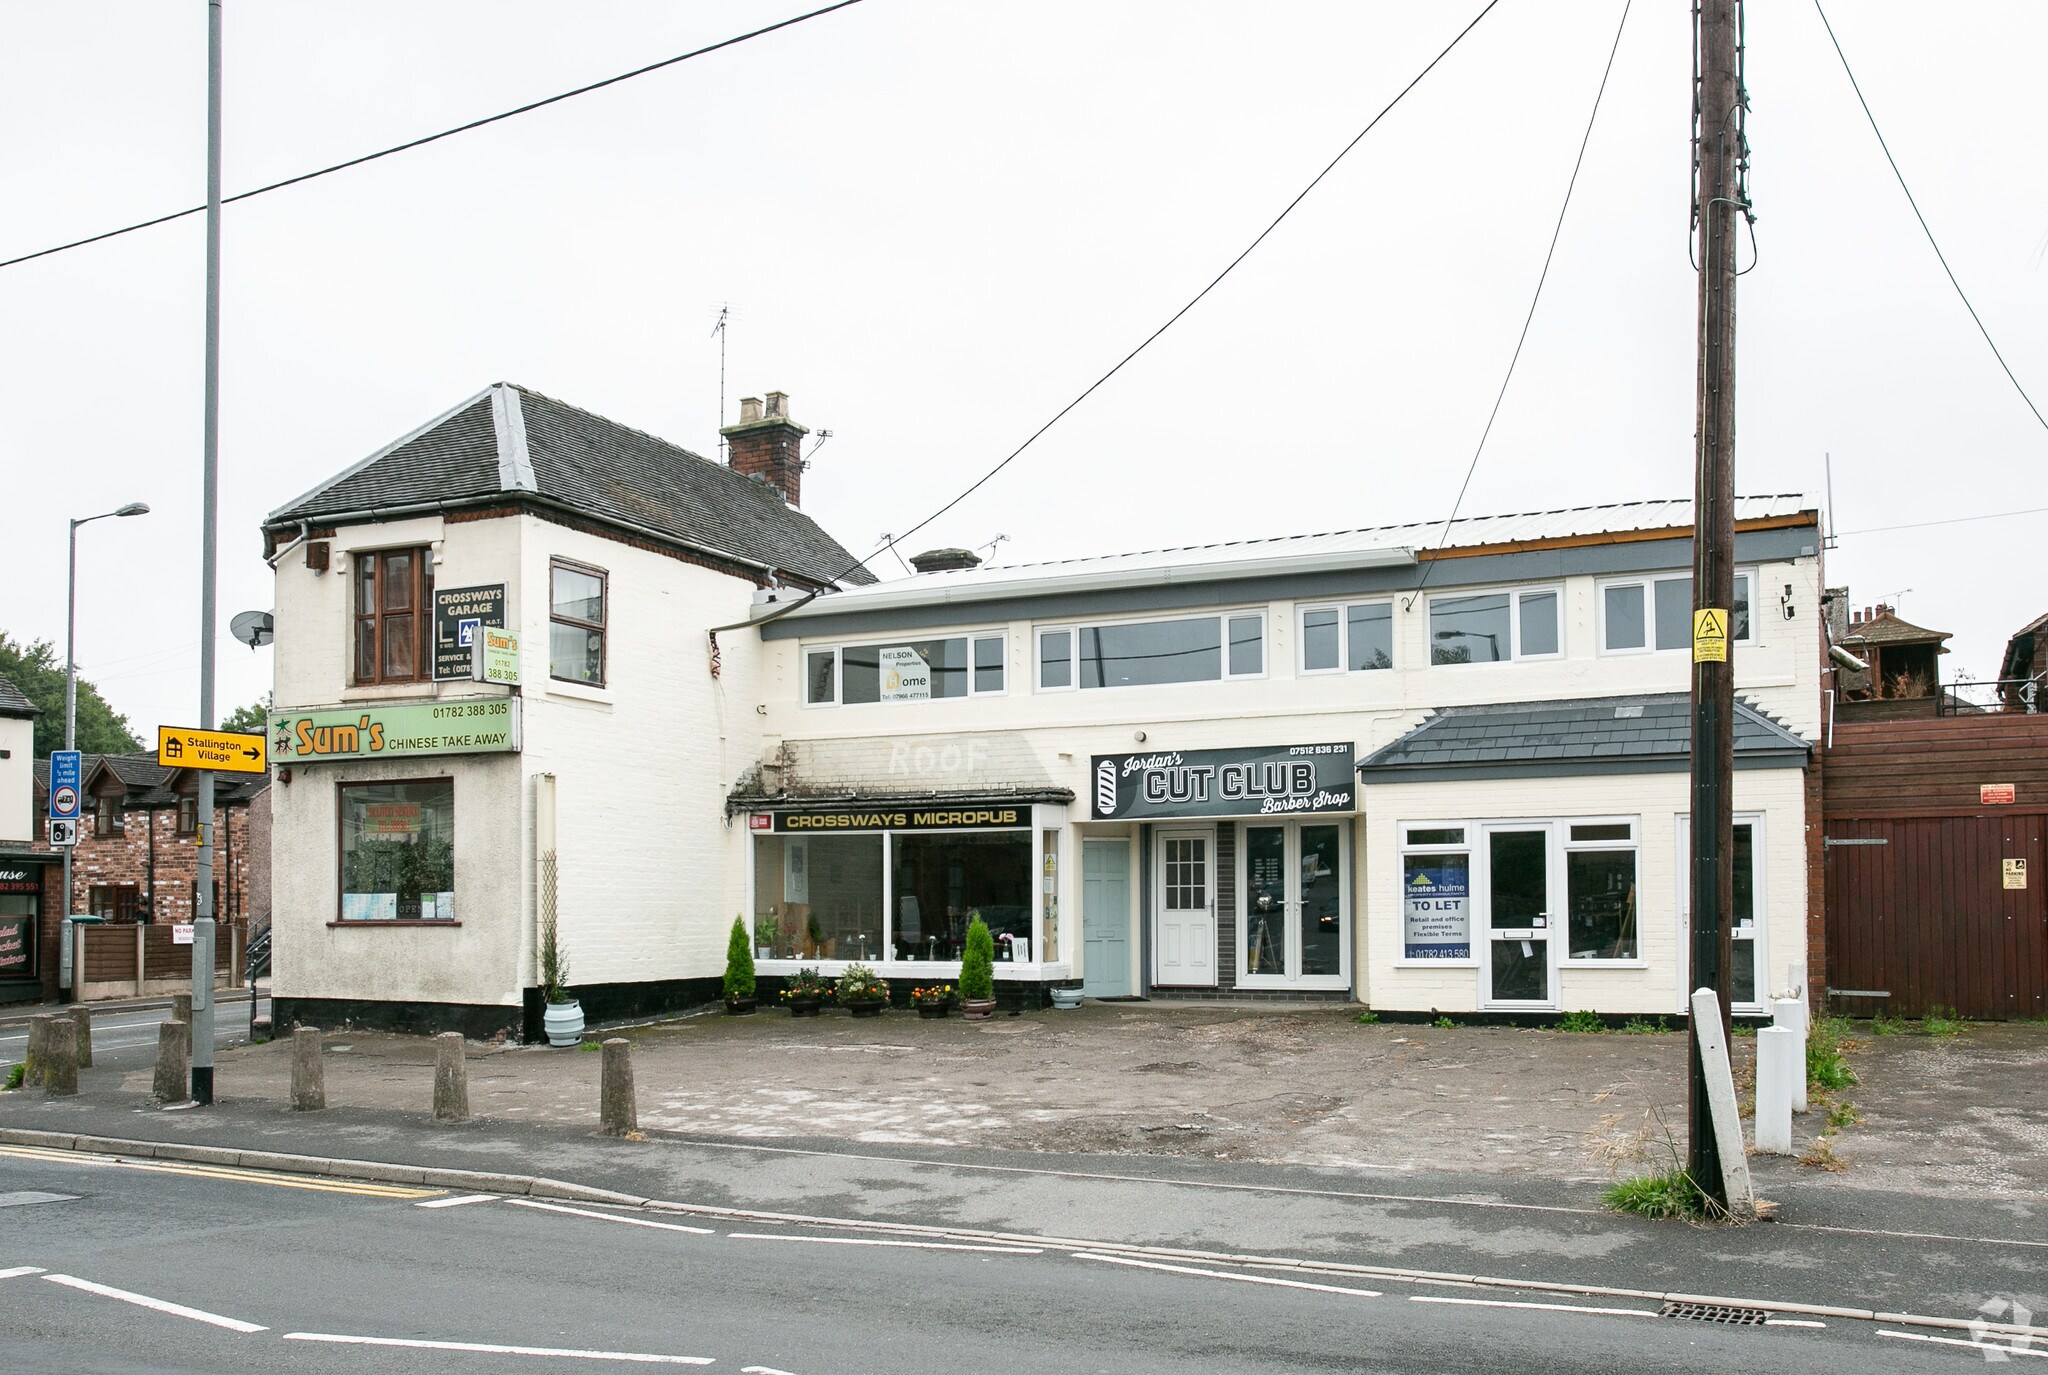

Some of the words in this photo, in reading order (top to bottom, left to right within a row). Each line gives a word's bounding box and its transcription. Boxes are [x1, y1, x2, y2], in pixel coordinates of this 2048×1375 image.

[438, 589, 502, 605] CROSSWAYS
[447, 602, 493, 616] GARAGE
[487, 632, 518, 651] Sum's
[438, 653, 464, 662] SERVICE
[882, 651, 913, 660] NELSON
[452, 664, 472, 675] (0178
[495, 659, 511, 668] 01782
[488, 668, 502, 679] 388
[504, 671, 518, 681] 305
[433, 708, 464, 719] 01782
[467, 705, 485, 716] 388
[488, 703, 507, 715] 305
[296, 714, 385, 756] Sum's
[389, 737, 438, 750] CHINESE
[442, 735, 471, 747] TAKE
[474, 732, 507, 745] AWAY
[187, 737, 242, 751] Stallington
[1290, 746, 1314, 756] 07512
[1333, 744, 1348, 753] 231
[56, 754, 77, 762] Weight
[198, 750, 231, 763] Village
[888, 738, 991, 776] ROOF
[1122, 751, 1184, 777] Jordan's
[63, 769, 76, 777] mile
[1143, 764, 1215, 804] CUT
[1218, 760, 1316, 801] CLUB
[1260, 796, 1311, 814] Barber
[1312, 790, 1350, 811] Shop
[786, 814, 907, 828] CROSSWAYS
[914, 810, 1017, 826] MICROPUB
[11, 882, 24, 891] 395
[1407, 885, 1436, 893] keates
[1439, 884, 1465, 892] hulme
[1412, 901, 1431, 911] TO
[1435, 900, 1461, 910] LET
